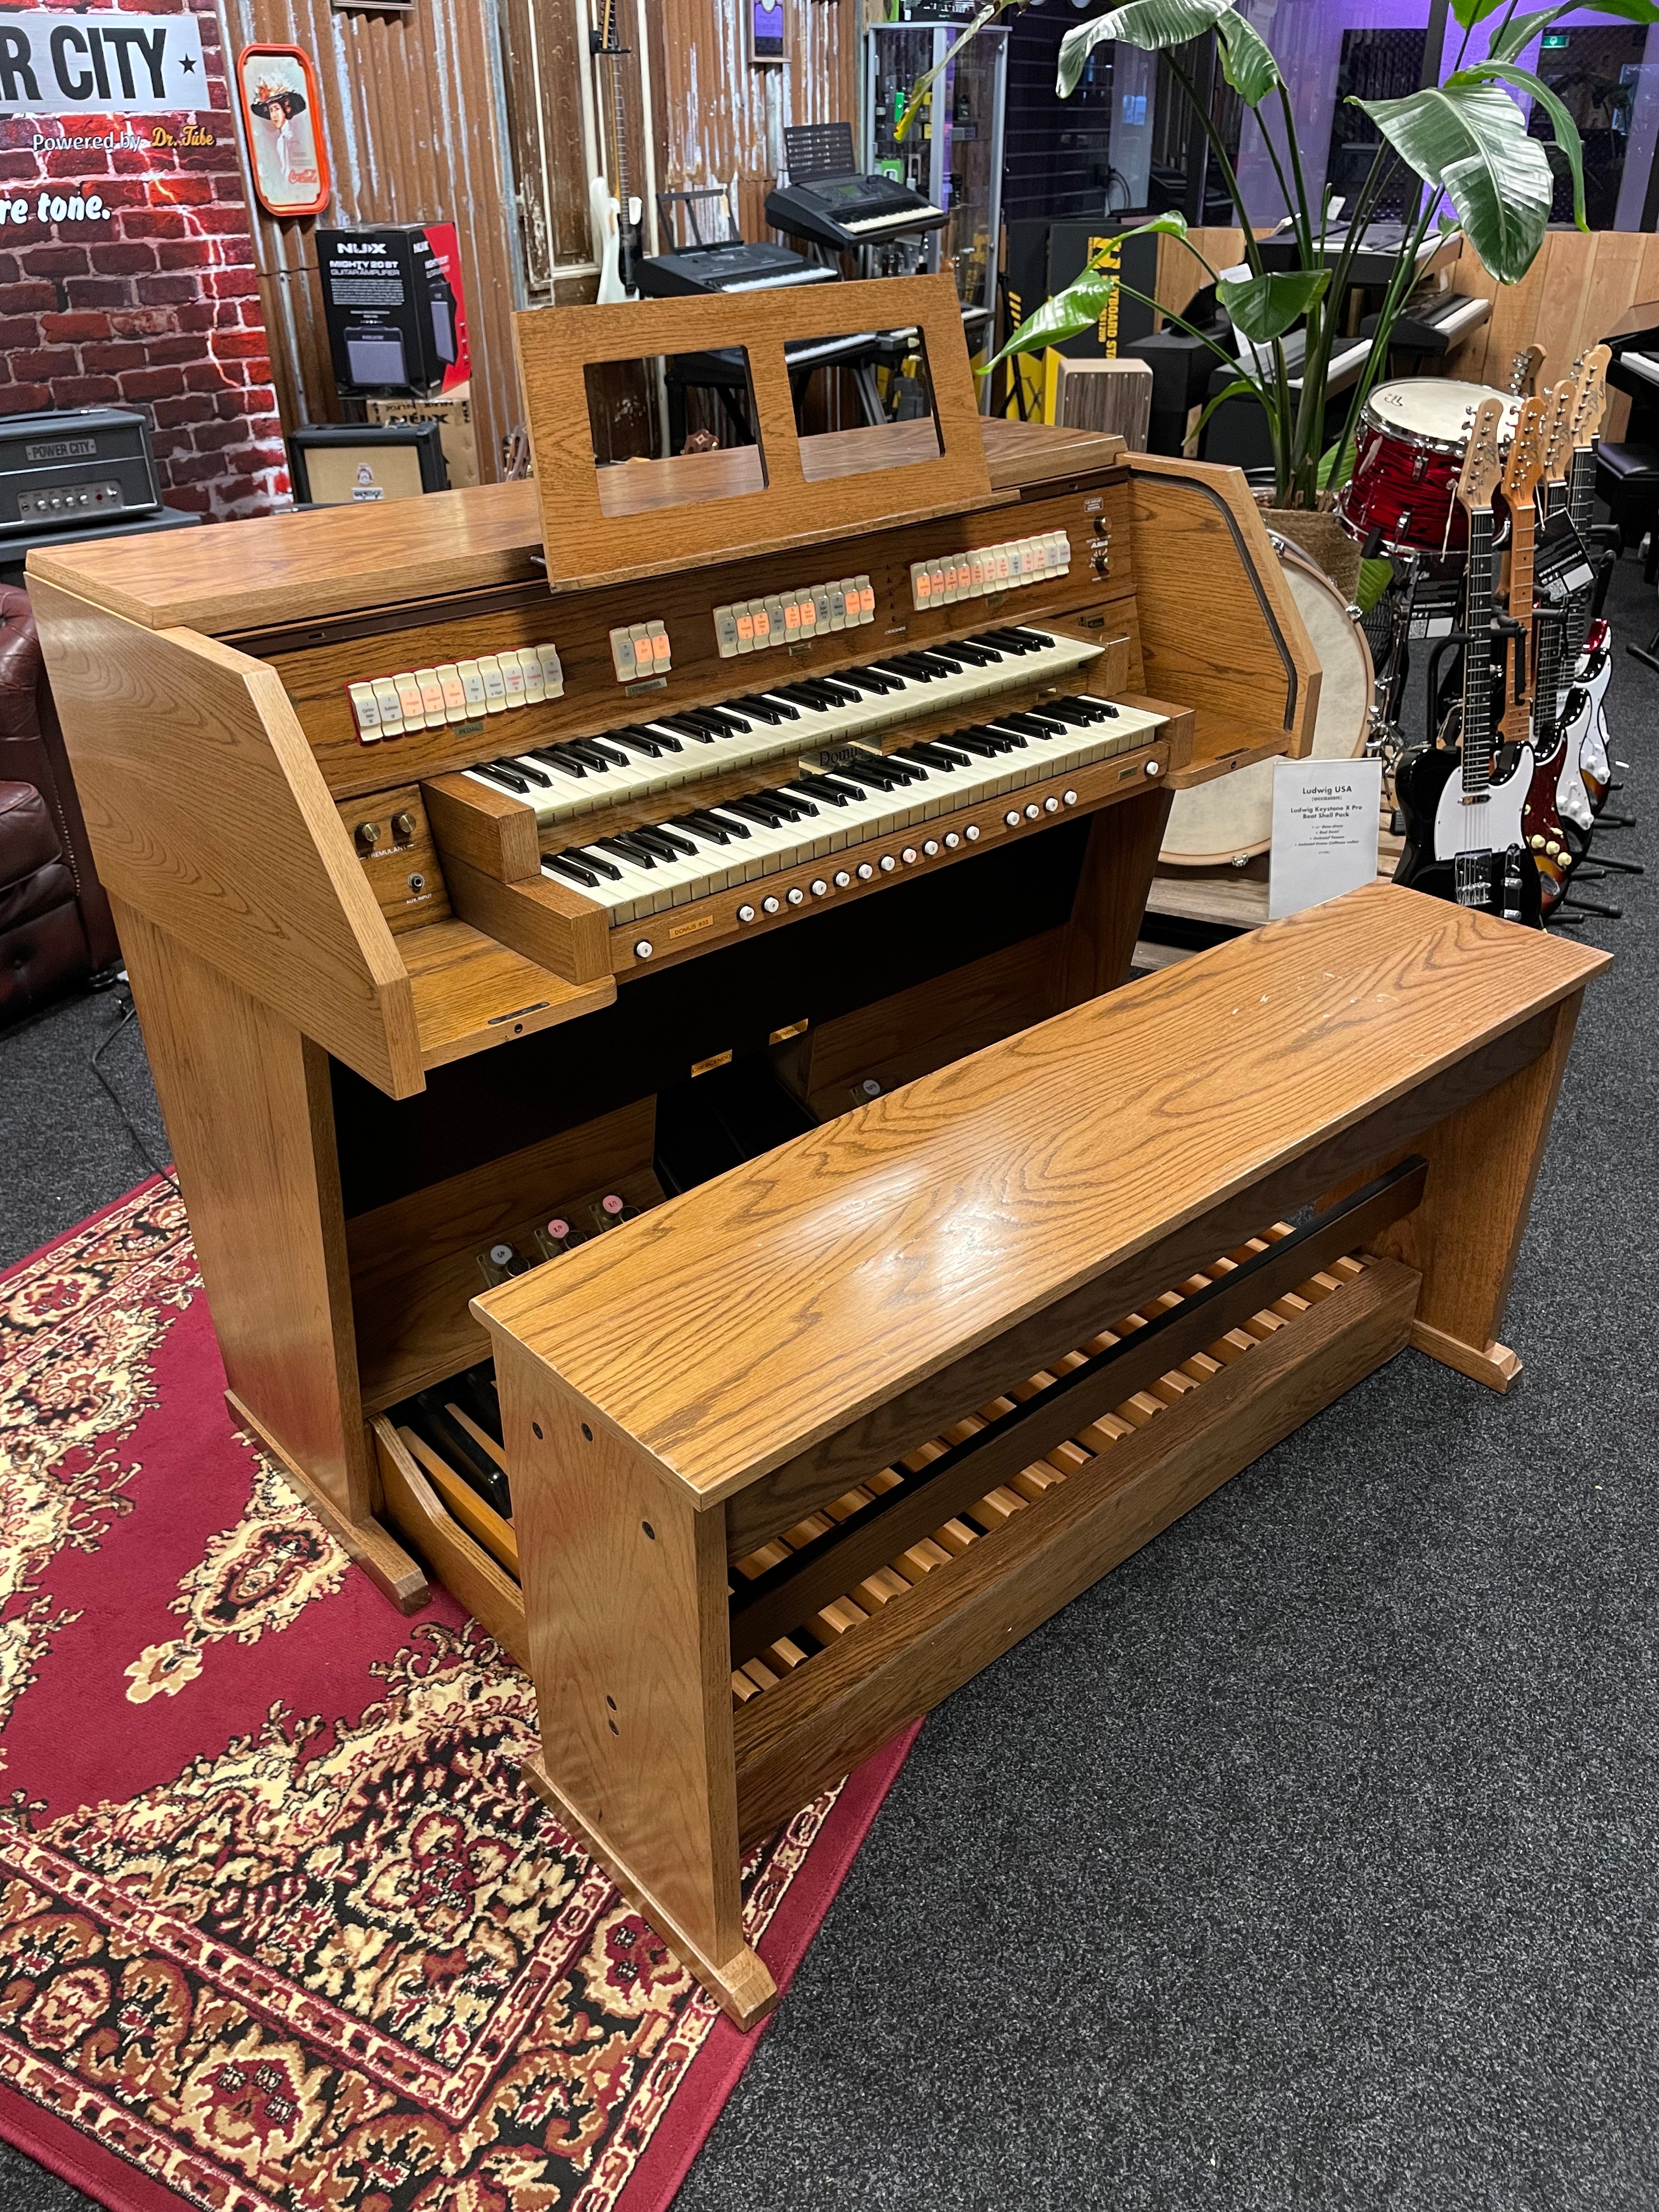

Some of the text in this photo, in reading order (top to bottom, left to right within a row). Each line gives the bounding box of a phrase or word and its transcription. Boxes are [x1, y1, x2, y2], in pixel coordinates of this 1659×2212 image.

[0, 25, 167, 100] R CITY
[33, 125, 215, 153] Powered by Dr. Tube
[37, 192, 110, 223] tone.
[337, 243, 387, 253] NUX
[329, 261, 369, 269] MIGHTY
[1107, 275, 1120, 337] KYBOARD
[32, 441, 89, 458] POWER CITY
[459, 726, 480, 735] PEDAL
[820, 743, 864, 766] Domus
[1302, 786, 1332, 795] Ludwig
[368, 845, 407, 859] TREMULANT
[674, 924, 696, 935] DOMUS
[775, 1026, 800, 1040] GENERAL
[692, 1053, 731, 1074] CRESCENDO
